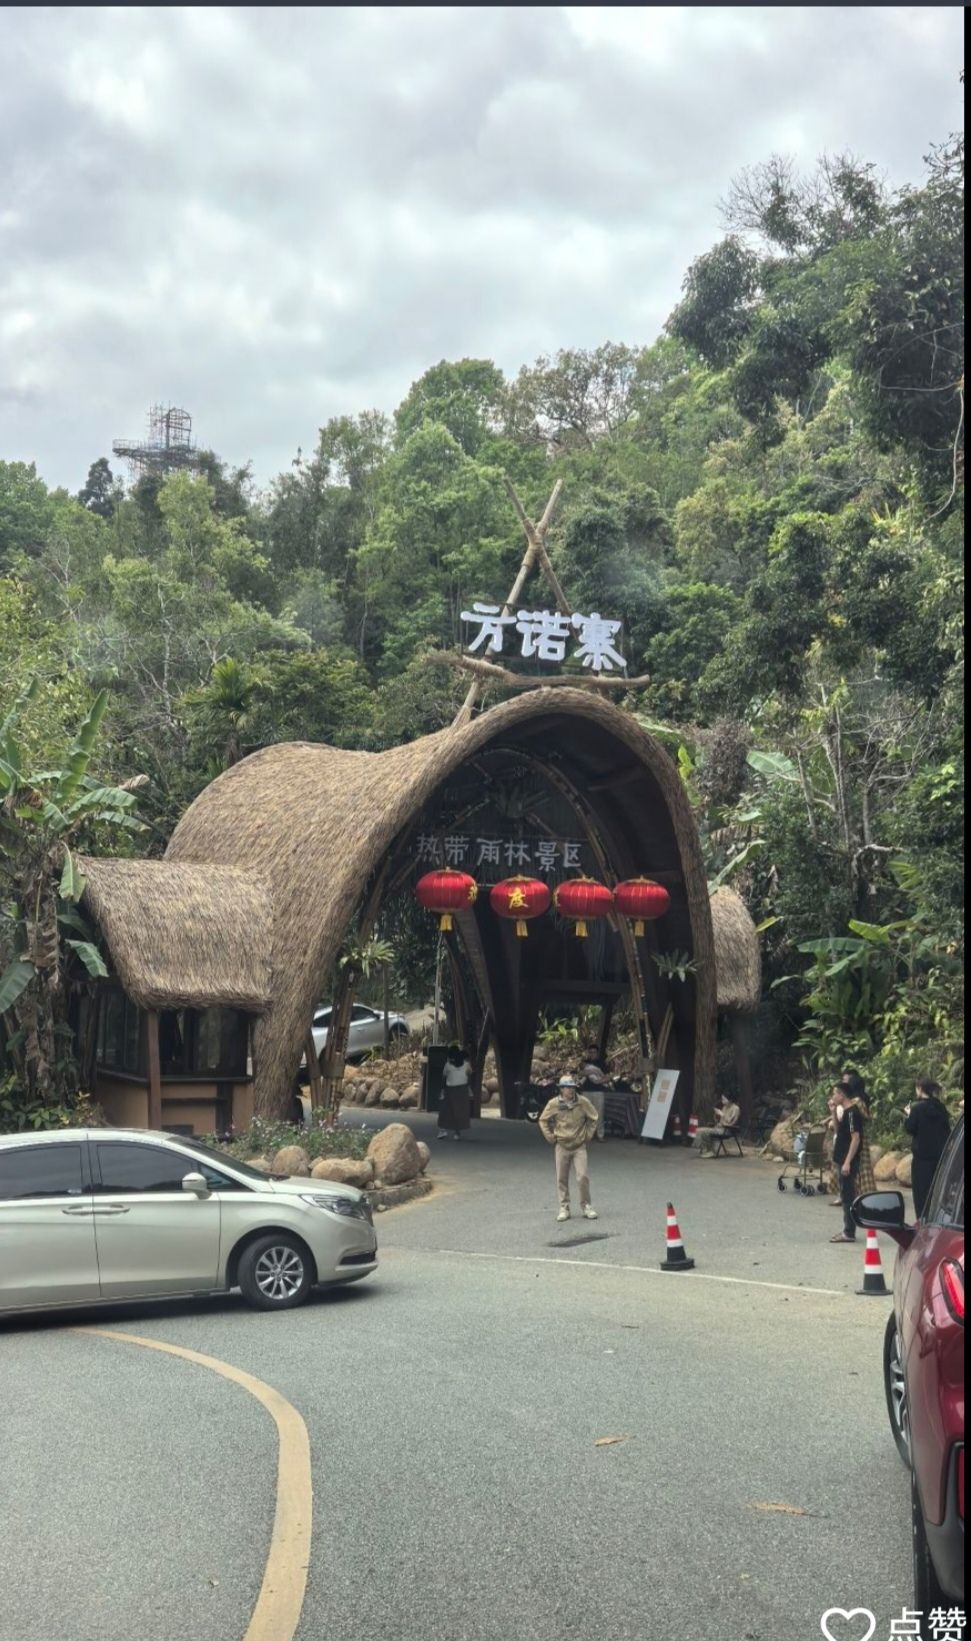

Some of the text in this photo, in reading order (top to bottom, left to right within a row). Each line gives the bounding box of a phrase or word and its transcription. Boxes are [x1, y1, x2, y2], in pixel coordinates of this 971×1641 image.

[460, 602, 628, 671] 方诺寨
[416, 833, 582, 872] 热带雨林景区
